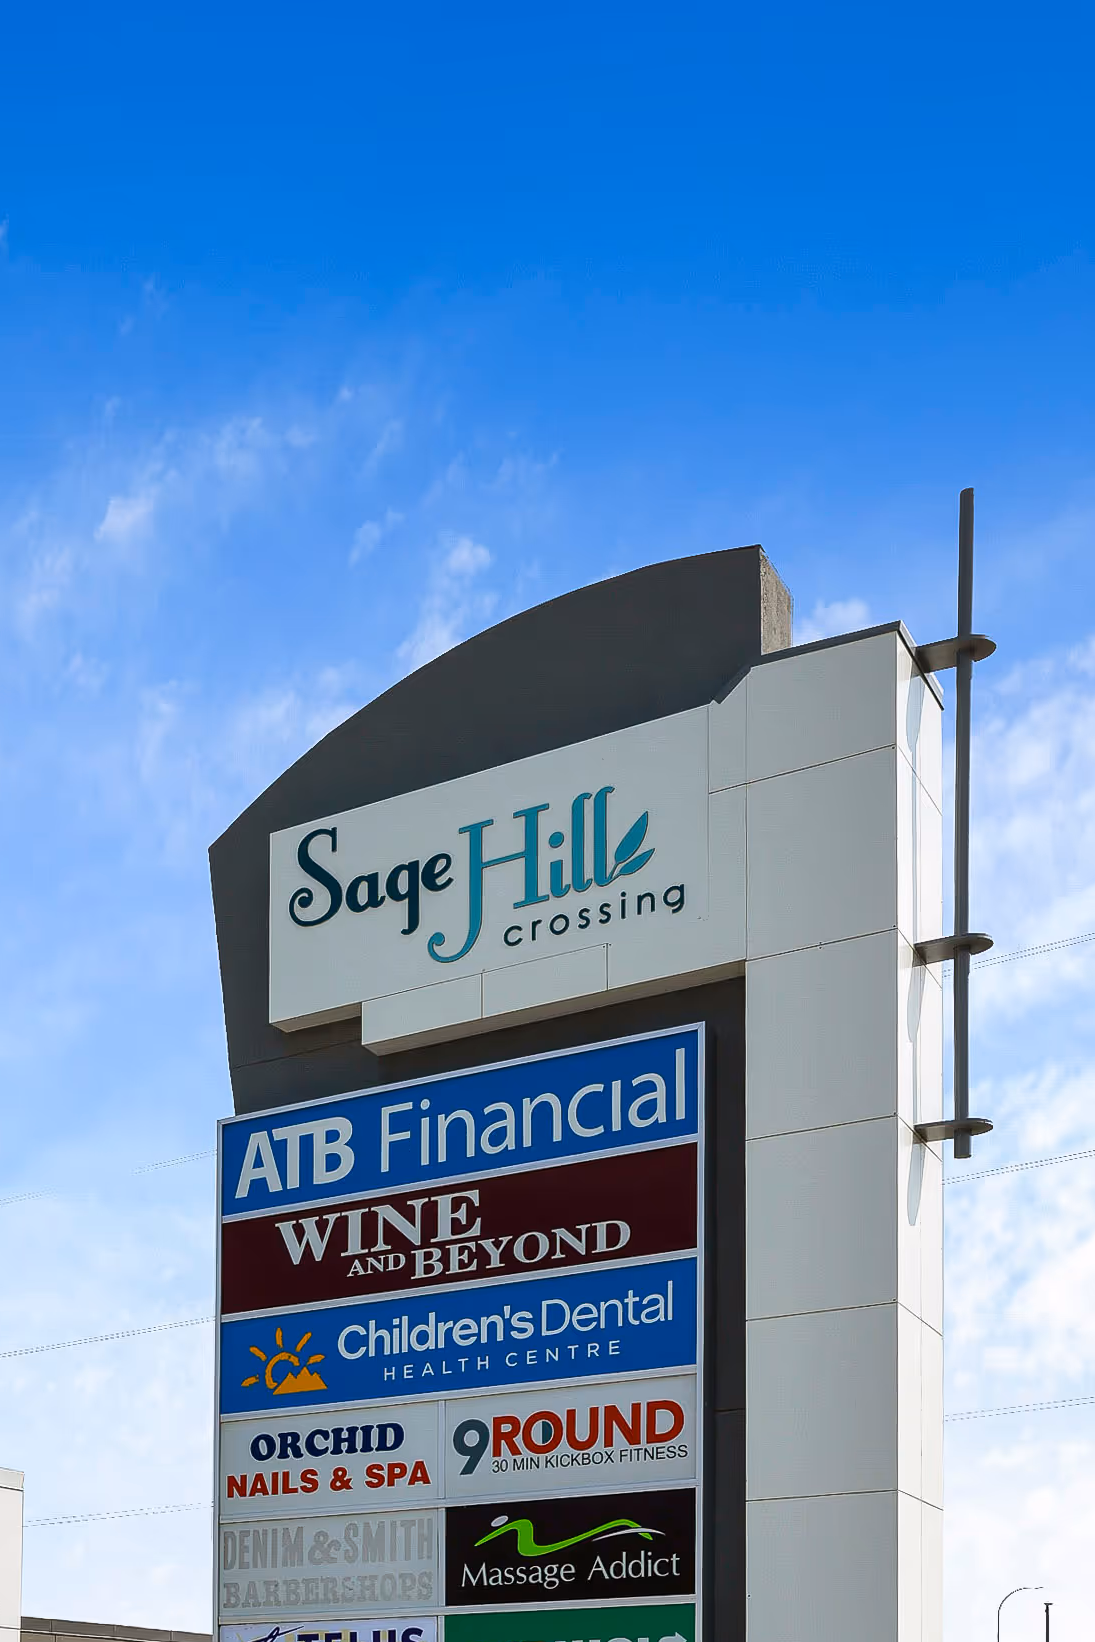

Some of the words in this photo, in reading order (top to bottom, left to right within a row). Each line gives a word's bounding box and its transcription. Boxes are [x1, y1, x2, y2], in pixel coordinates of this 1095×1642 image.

[288, 826, 455, 935] Sage
[427, 786, 623, 962] Hill
[503, 880, 687, 946] crossing
[234, 1116, 356, 1199] ATB
[380, 1047, 687, 1173] Financial
[275, 1189, 482, 1265] WINE
[347, 1253, 406, 1277] AND
[410, 1220, 632, 1280] BEYOND
[337, 1304, 535, 1360] Children's
[541, 1280, 674, 1337] Dental
[383, 1354, 490, 1382] HEALTH
[506, 1340, 622, 1367] CENTRE
[250, 1422, 405, 1462] ORCHID
[491, 1458, 509, 1474] 30
[512, 1456, 540, 1472] MIN
[544, 1450, 615, 1469] KICKBOX
[619, 1444, 689, 1463] FITNESS
[226, 1467, 319, 1498] NAILS
[329, 1465, 353, 1491] &
[364, 1460, 431, 1488] SPA
[223, 1526, 304, 1570] DENIM
[307, 1530, 342, 1566] &
[343, 1518, 434, 1565] SMITH
[461, 1561, 576, 1589] Massage
[588, 1551, 680, 1581] Addict
[223, 1571, 434, 1609] BARBERSHOPS
